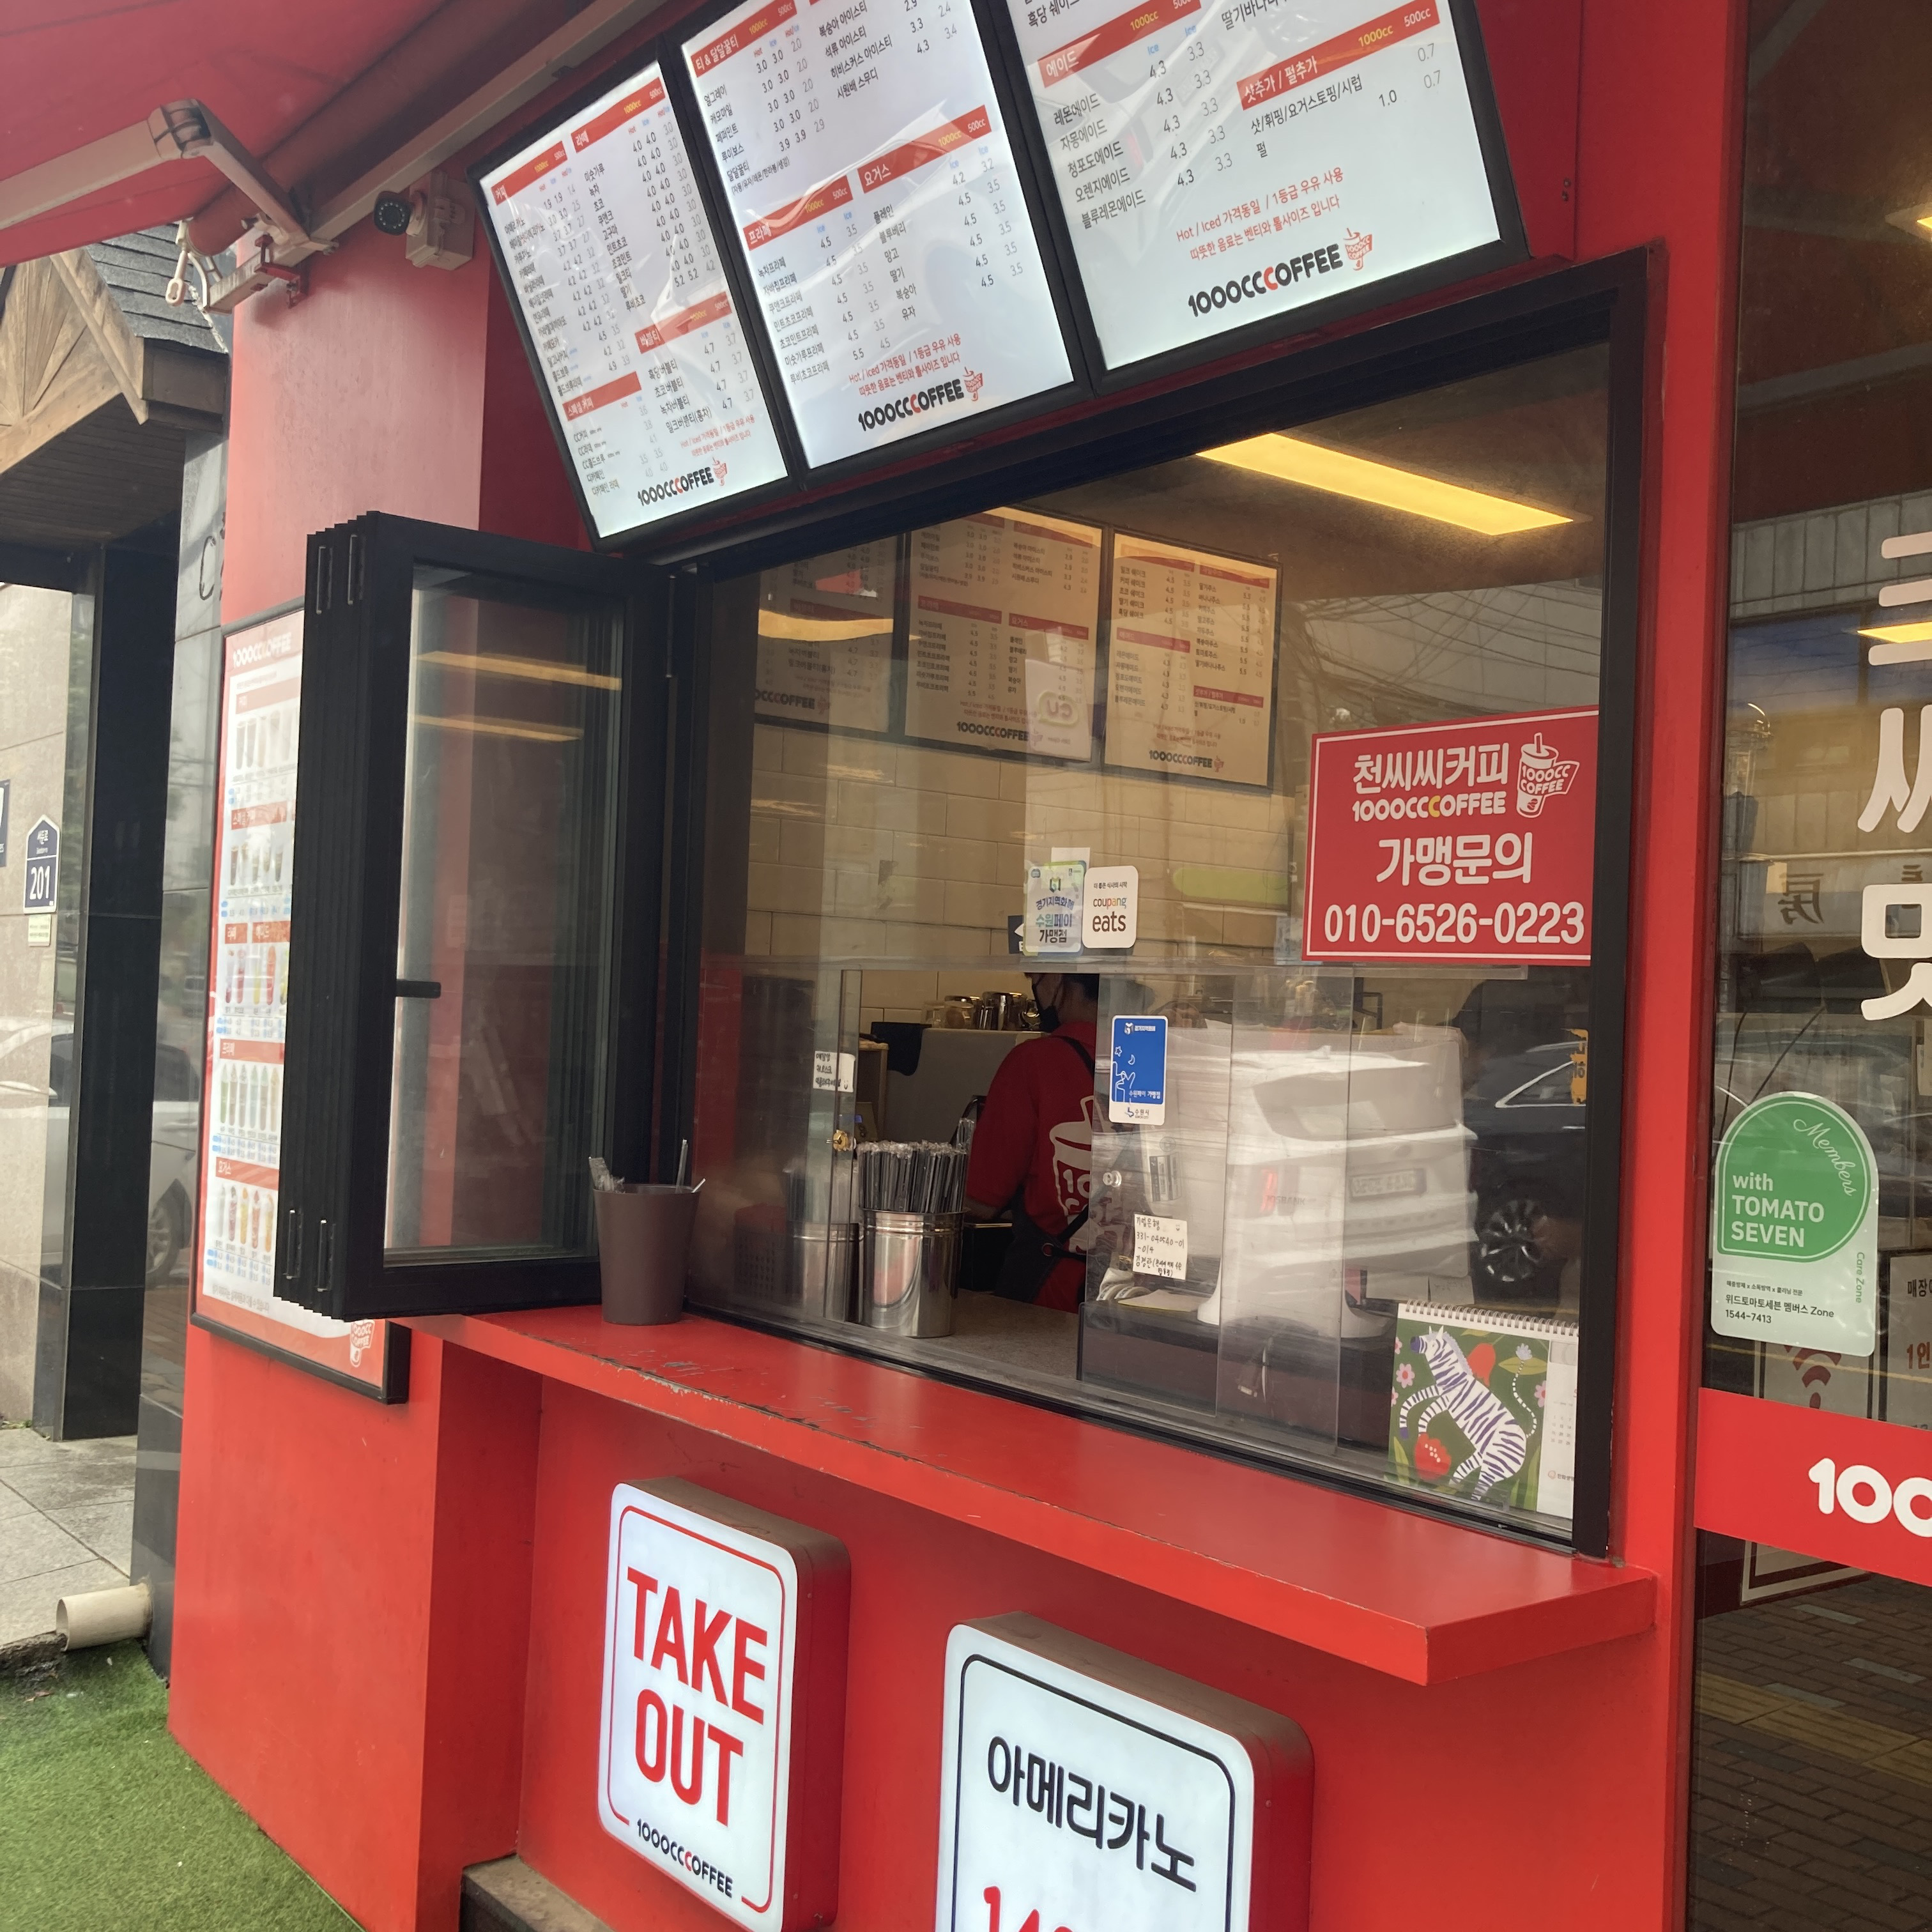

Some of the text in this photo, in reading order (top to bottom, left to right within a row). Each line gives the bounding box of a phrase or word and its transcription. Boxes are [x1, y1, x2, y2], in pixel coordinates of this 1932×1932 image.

[694, 1, 793, 72] 티 & 달달꿀티 1000cc 500cc
[829, 1, 952, 80] 히비스커스 아이스티 3.3 2.4
[1025, 3, 1049, 30] 흑당
[835, 23, 958, 100] 시원배 스무디 4.3 3.4
[1044, 7, 1160, 80] 에이드 1000cc
[1243, 74, 1276, 104] 샷추가
[1284, 54, 1319, 86] 펄추가
[1357, 22, 1394, 49] 1000cc
[1402, 4, 1432, 29] 500cc
[1416, 42, 1437, 63] 0.7
[703, 84, 728, 107] 얼그레이
[755, 58, 768, 74] 3.0
[770, 48, 784, 65] 3.0
[1052, 40, 1206, 127] 레몬에이드 4.3 3.3
[623, 97, 641, 116] 1000cc
[1059, 68, 1213, 153] 자몽에이드 4.3 3.3
[1256, 68, 1444, 158] 펄 1.0 0.7
[583, 162, 606, 184] 미숫가루
[631, 139, 643, 154] 4.0
[644, 130, 657, 146] 4.0
[720, 141, 745, 162] 루이보스
[772, 118, 785, 133] 3.0
[788, 109, 801, 124] 3.0
[778, 137, 791, 152] 3.9
[794, 128, 807, 144] 3.9
[862, 116, 986, 187] 요거스 1000cc 500cc
[1066, 96, 1220, 179] 청포도에이드 4.3 3.3
[1073, 123, 1226, 204] 오렌지에이드 4.3 3.3
[1079, 151, 1233, 229] 블루레몬에이드 4.3 3.3
[1176, 226, 1195, 242] Hot
[1200, 214, 1222, 233] Iced
[1222, 198, 1261, 226] 가격동일
[1271, 183, 1299, 206] 1등급
[1299, 174, 1322, 196] 우유
[1321, 165, 1345, 188] 사용
[1190, 194, 1341, 263] 따뜻한 음료는 벤티와 톨사이즈 입니다
[819, 235, 832, 250] 4.5
[845, 223, 857, 237] 3.5
[884, 199, 1006, 263] 망고 4.5 3.5
[895, 241, 1017, 302] 복숭아 4.5 3.5
[901, 262, 1023, 321] 유자 4.5 3.5
[1186, 242, 1344, 318] 1000CCCOFFEE
[647, 332, 737, 382] 흑당버블티 4.7 3.7
[653, 350, 744, 399] 초코버블티 4.7 3.7
[856, 378, 965, 433] 1000CCCOFFEE
[636, 465, 715, 507] 1000CCCOFFEE
[957, 721, 1029, 742] 1000CCCOFFEE
[1149, 749, 1213, 768] 1000CCCOFFEE
[1353, 742, 1510, 794] 천씨씨커피
[1521, 764, 1570, 783] 1000CC
[1352, 791, 1507, 822] 1000CCCOFFEE
[1520, 779, 1565, 794] COFFEE
[29, 865, 50, 900] 201
[1376, 832, 1533, 886] 가맹문의
[1036, 914, 1073, 928] 수원페이
[1092, 911, 1127, 932] eats
[1093, 897, 1127, 910] coupang
[1324, 901, 1585, 944] 010-6526-0223
[1039, 929, 1068, 944] 가맹점
[1732, 1172, 1774, 1192] with
[1793, 1119, 1857, 1197] Members
[1731, 1194, 1825, 1223] TOMATO
[1731, 1220, 1805, 1248] SEVEN
[1855, 1252, 1866, 1303] Care Zone
[1725, 1294, 1835, 1318] 위드토마토세븐 멤버스 Zone
[1725, 1309, 1772, 1324] 1544-7413
[627, 1566, 768, 1725] TAKE
[635, 1689, 744, 1828] OUT
[987, 1735, 1197, 1892] 아메리카노
[637, 1818, 733, 1899] 1000CCCOFFEE
